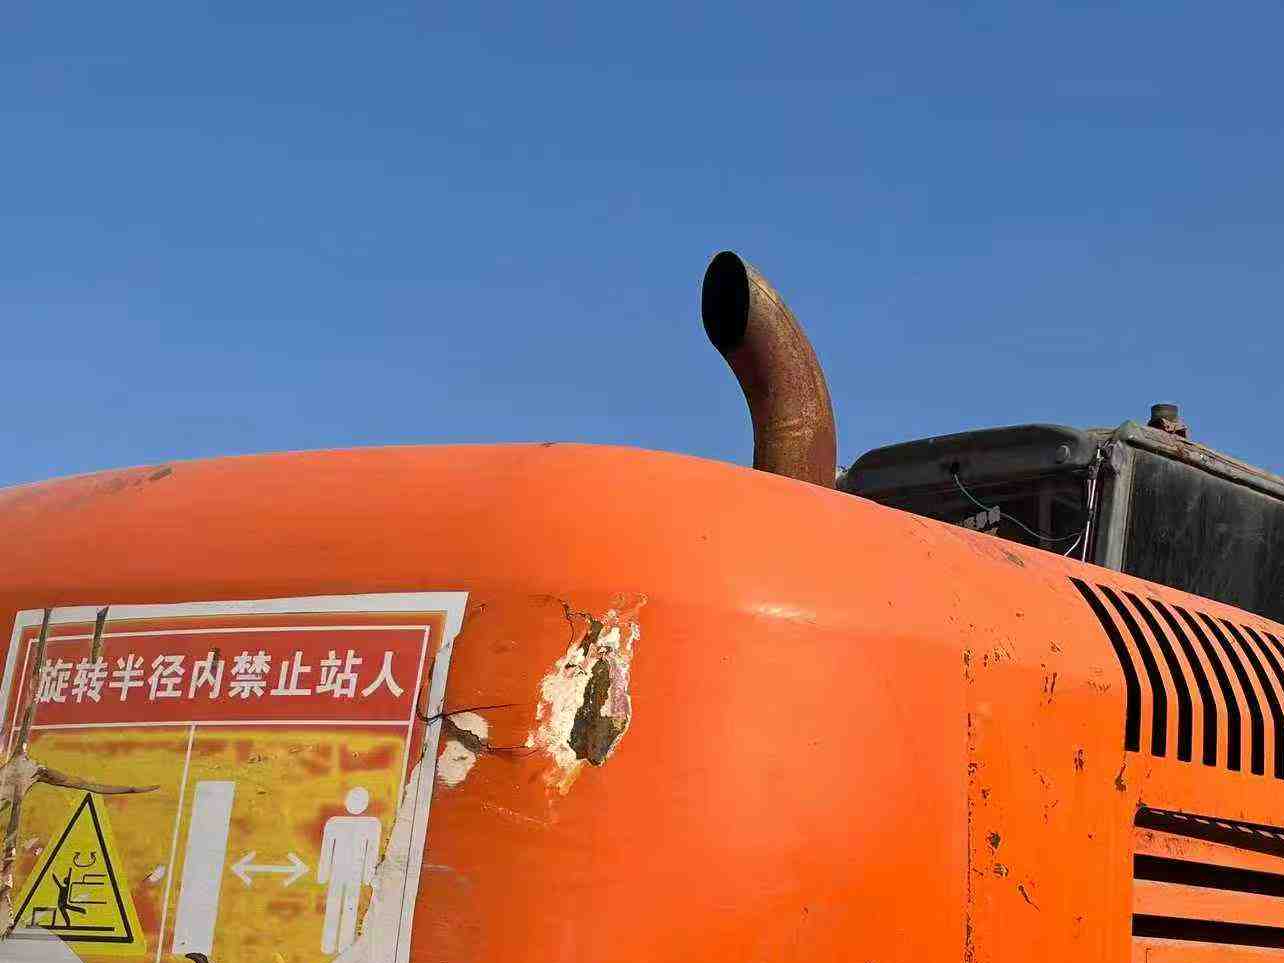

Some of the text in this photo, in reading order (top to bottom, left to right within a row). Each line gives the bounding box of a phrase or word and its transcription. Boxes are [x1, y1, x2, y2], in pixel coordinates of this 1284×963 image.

[34, 650, 404, 704] 旋转半径内禁止站人
